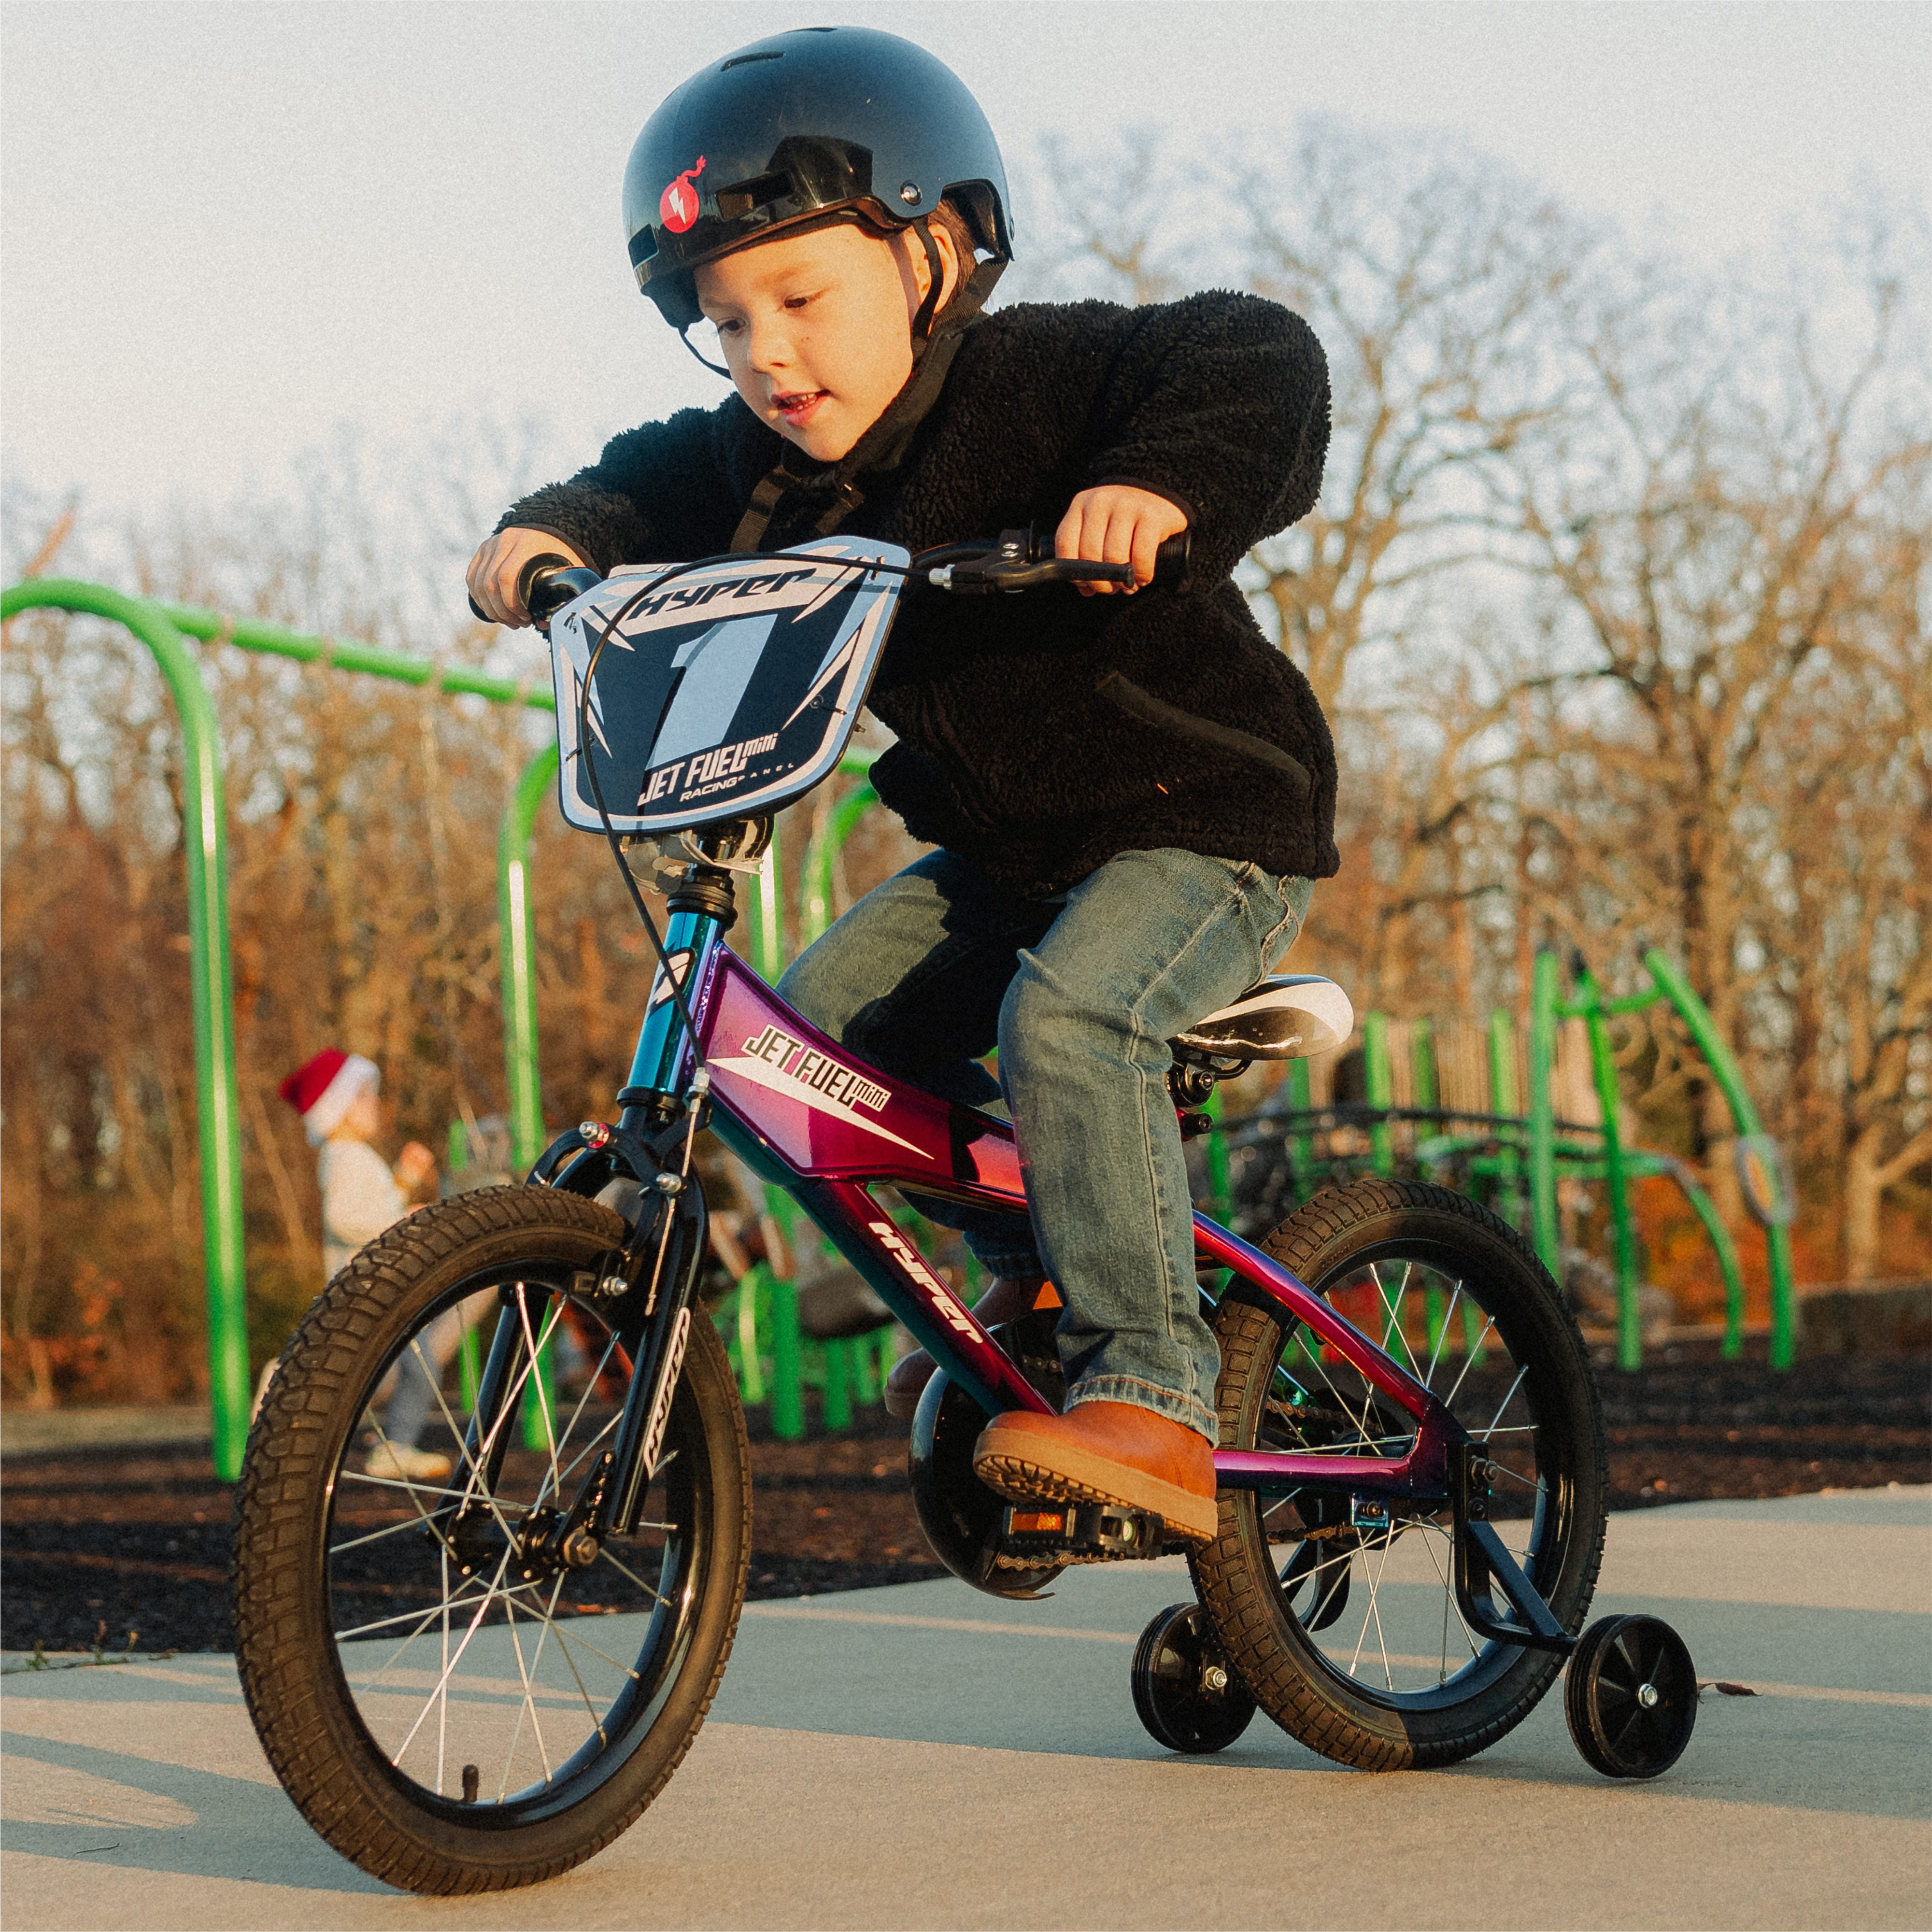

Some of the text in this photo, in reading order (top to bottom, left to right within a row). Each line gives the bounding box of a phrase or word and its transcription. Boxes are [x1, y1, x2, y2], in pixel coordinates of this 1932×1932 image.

[645, 613, 778, 770] 1
[637, 762, 686, 806] JET
[679, 777, 739, 802] RACING
[746, 1027, 801, 1069] JET
